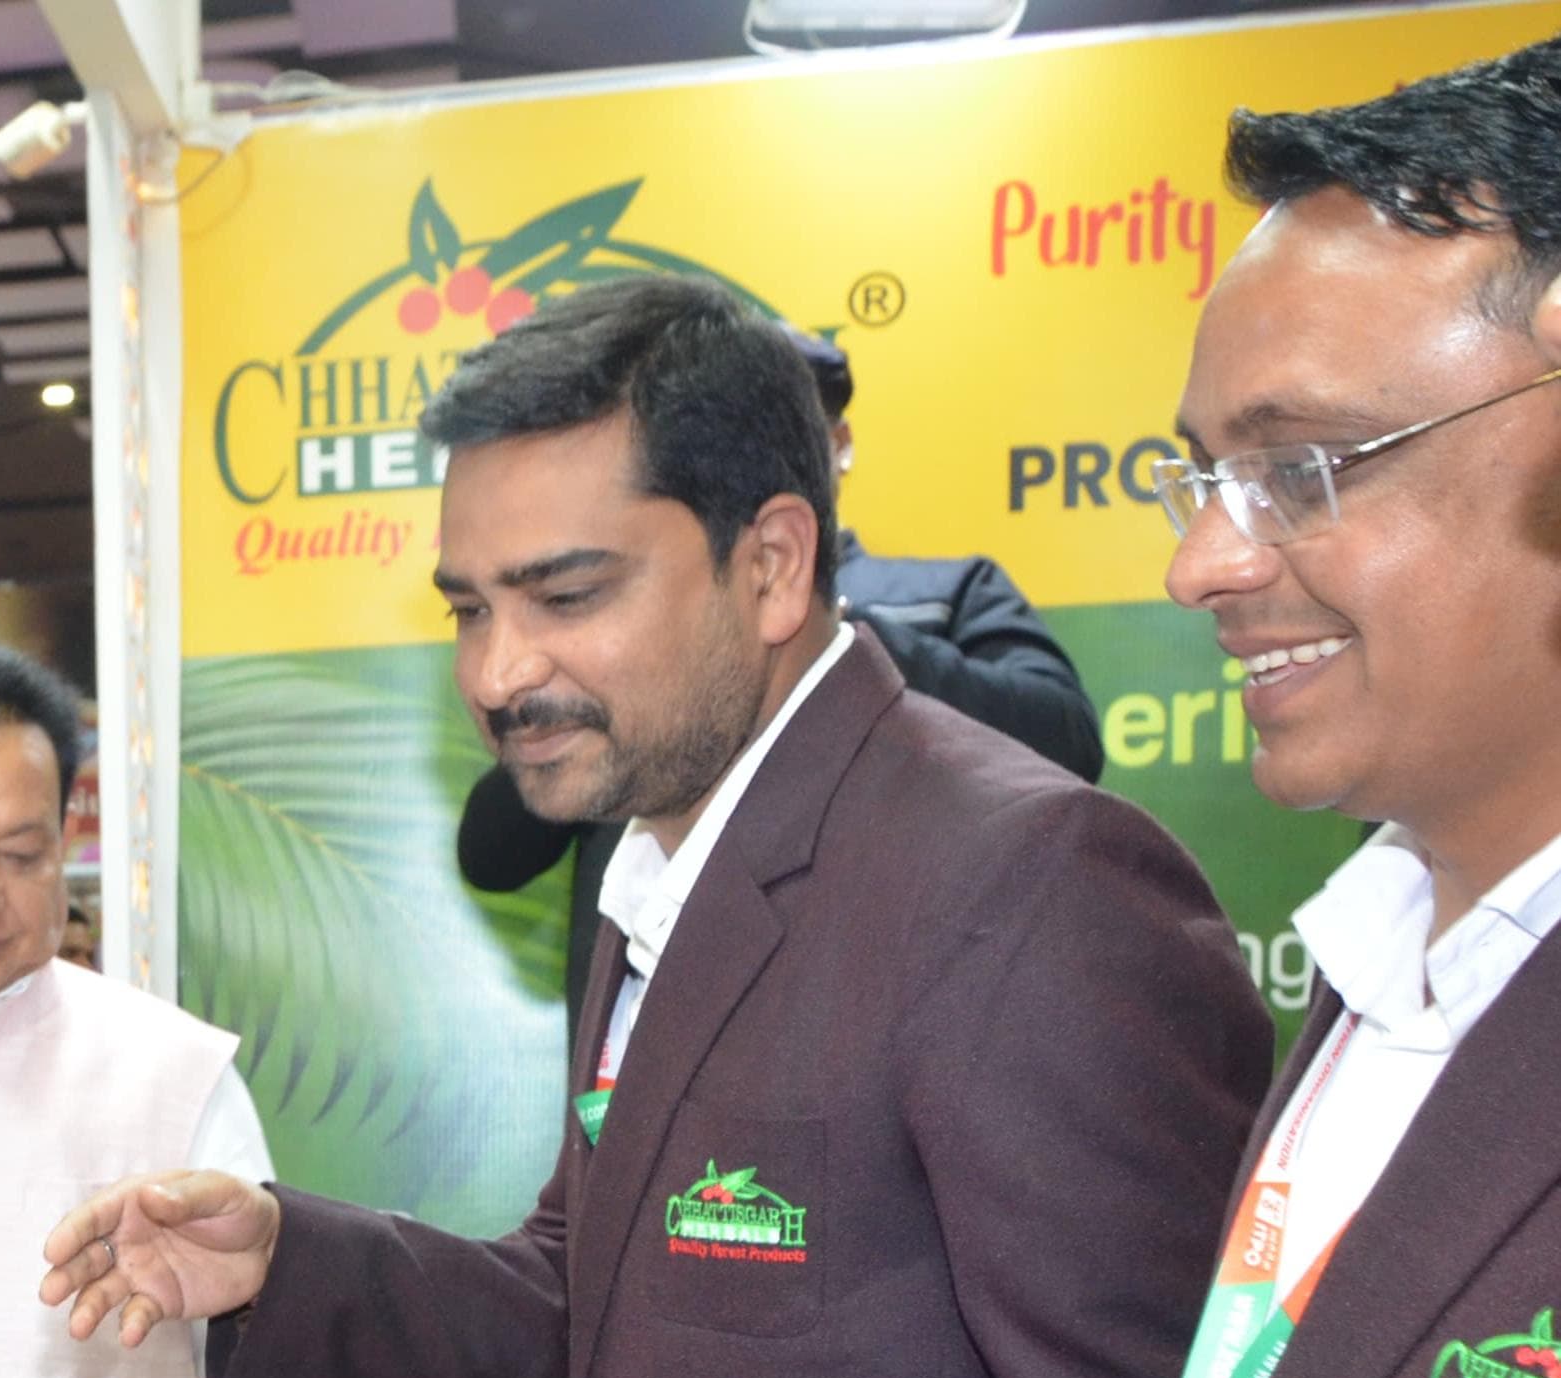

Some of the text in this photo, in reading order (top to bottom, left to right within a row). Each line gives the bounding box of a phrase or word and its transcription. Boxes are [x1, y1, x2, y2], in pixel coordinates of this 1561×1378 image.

[990, 175, 1217, 302] Purity
[214, 352, 467, 506] CHHA
[234, 509, 413, 577] Quality
